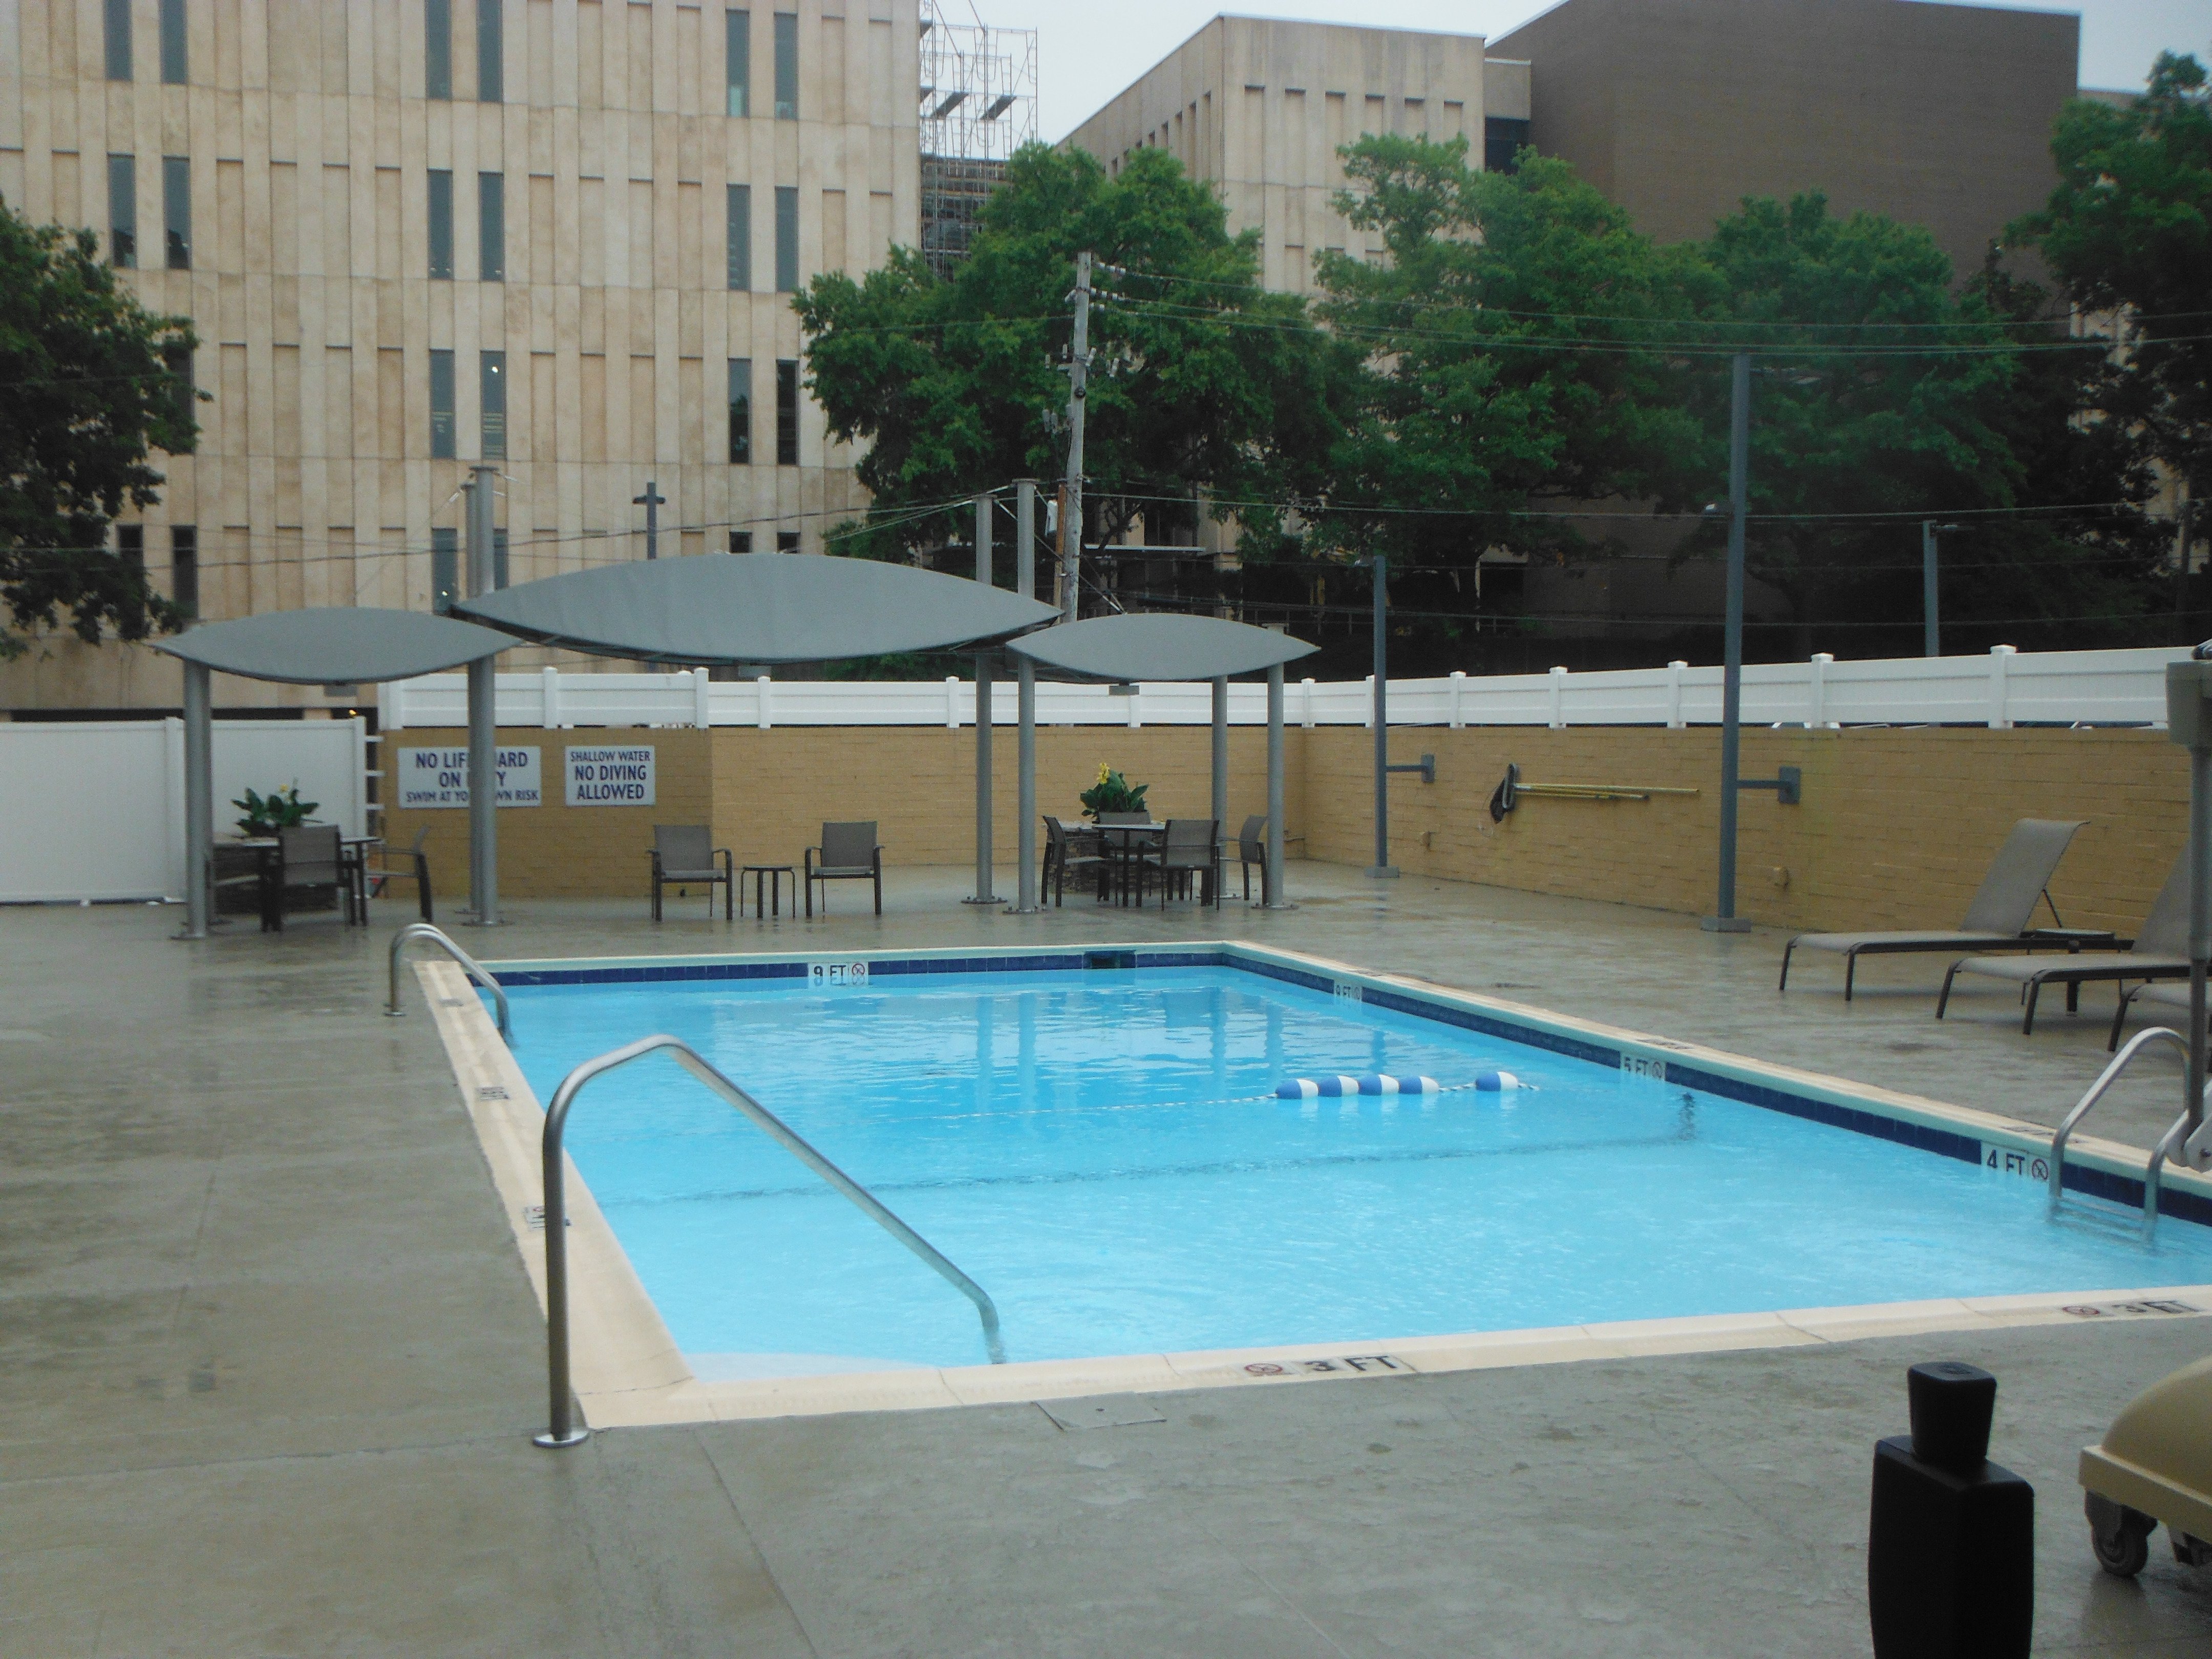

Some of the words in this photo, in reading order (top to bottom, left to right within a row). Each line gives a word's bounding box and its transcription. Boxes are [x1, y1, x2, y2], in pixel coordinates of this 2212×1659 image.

[415, 753, 437, 768] NO
[443, 752, 528, 768] LIFARD
[570, 751, 615, 762] SHALLOW
[618, 751, 650, 761] WATER
[439, 772, 461, 788] ON
[576, 765, 594, 781] NO
[600, 764, 647, 780] DIVING
[406, 791, 437, 802] SWIM
[440, 791, 451, 802] AT
[515, 790, 539, 801] RISK
[577, 784, 645, 800] ALLOWED
[814, 965, 823, 976] 9
[830, 965, 846, 976] FT
[1987, 1149, 1997, 1168] 4
[2006, 1153, 2025, 1176] FT
[1304, 1360, 1336, 1371] 3
[1344, 1355, 1397, 1371] FT
